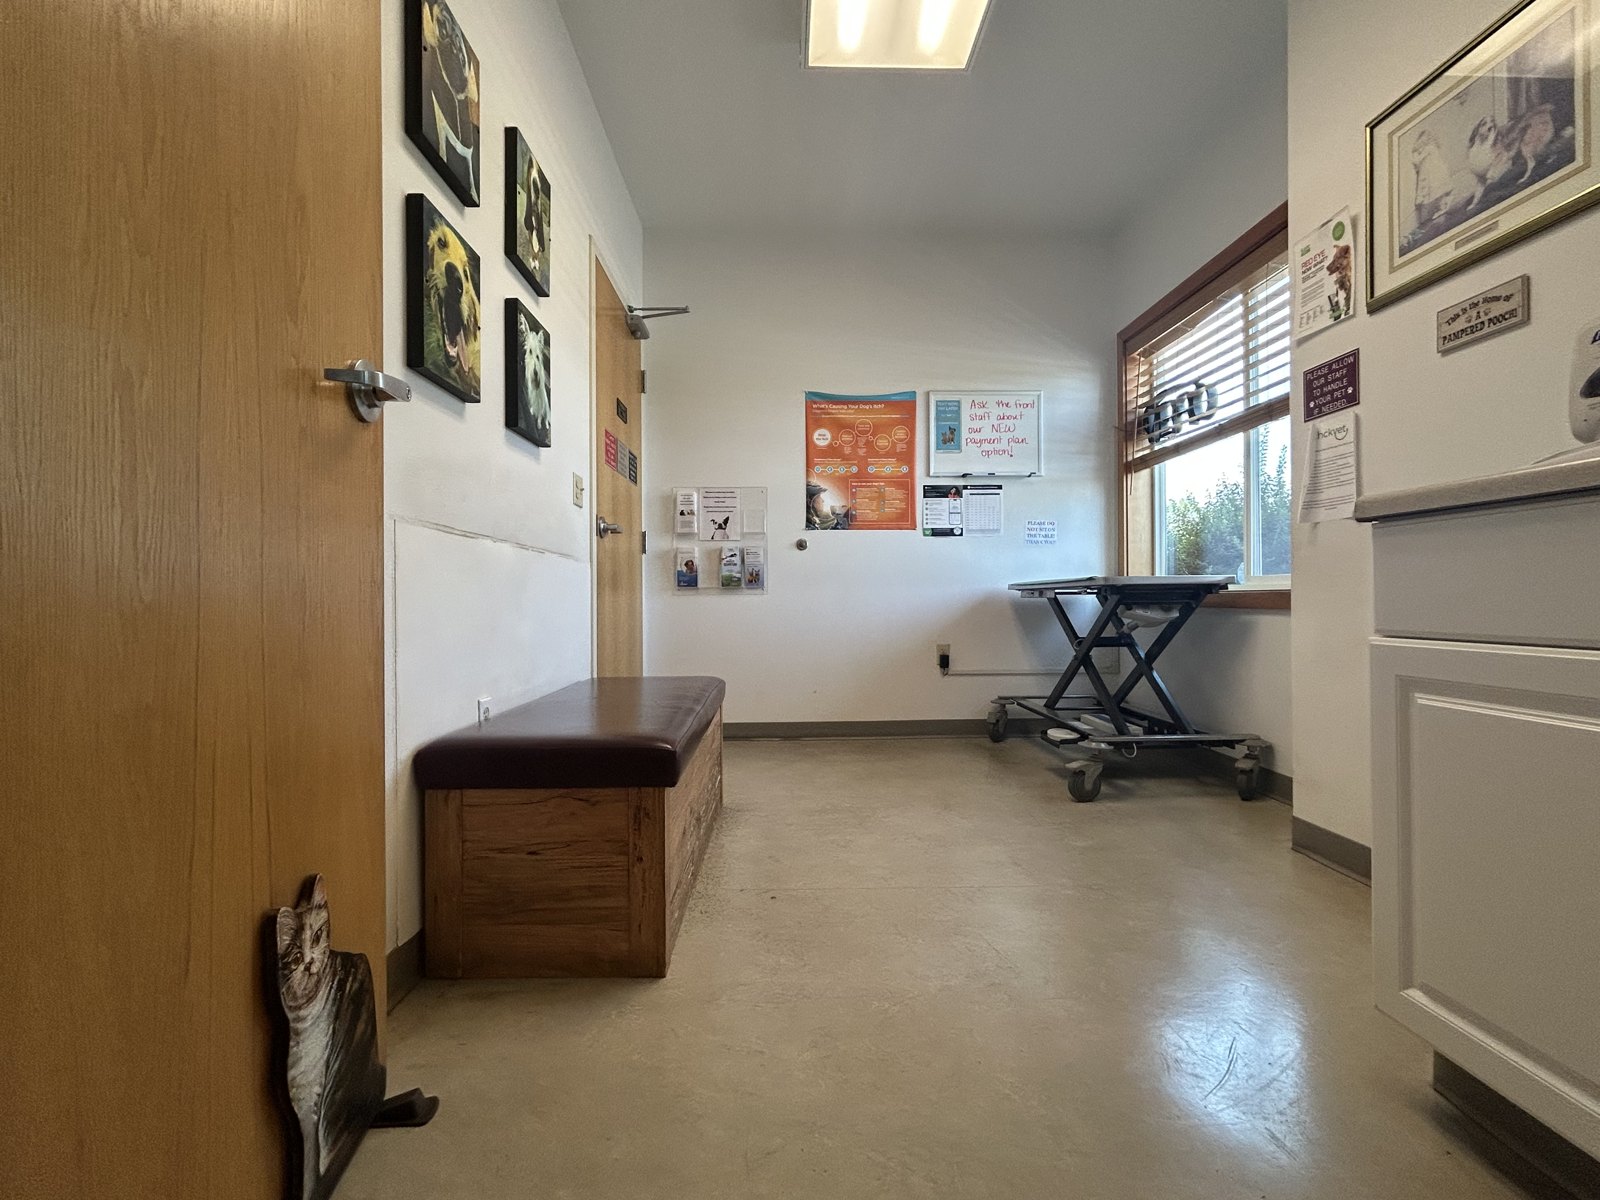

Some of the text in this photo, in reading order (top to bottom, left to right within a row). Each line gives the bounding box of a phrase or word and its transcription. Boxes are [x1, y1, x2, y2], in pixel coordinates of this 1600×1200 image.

[1301, 257, 1313, 270] RED
[1313, 248, 1326, 262] EYE
[1302, 266, 1313, 275] NOW
[1445, 313, 1461, 326] This
[1469, 300, 1480, 310] the
[1482, 295, 1502, 304] Home
[1503, 293, 1514, 302] of
[1475, 310, 1481, 321] A
[1442, 307, 1518, 345] PAMPERED POOCH!
[1306, 354, 1355, 381] PLEASE ALLOW
[1312, 368, 1348, 388] OUR STAFF
[1312, 378, 1348, 397] TO HANDLE
[1314, 388, 1346, 405] YOUR PET
[969, 399, 1035, 410] Ask the front
[969, 411, 1024, 422] staff about
[1313, 407, 1319, 416] IF
[968, 423, 1016, 434] our NEW
[965, 435, 1029, 448] payment plan
[981, 445, 1013, 458] option!
